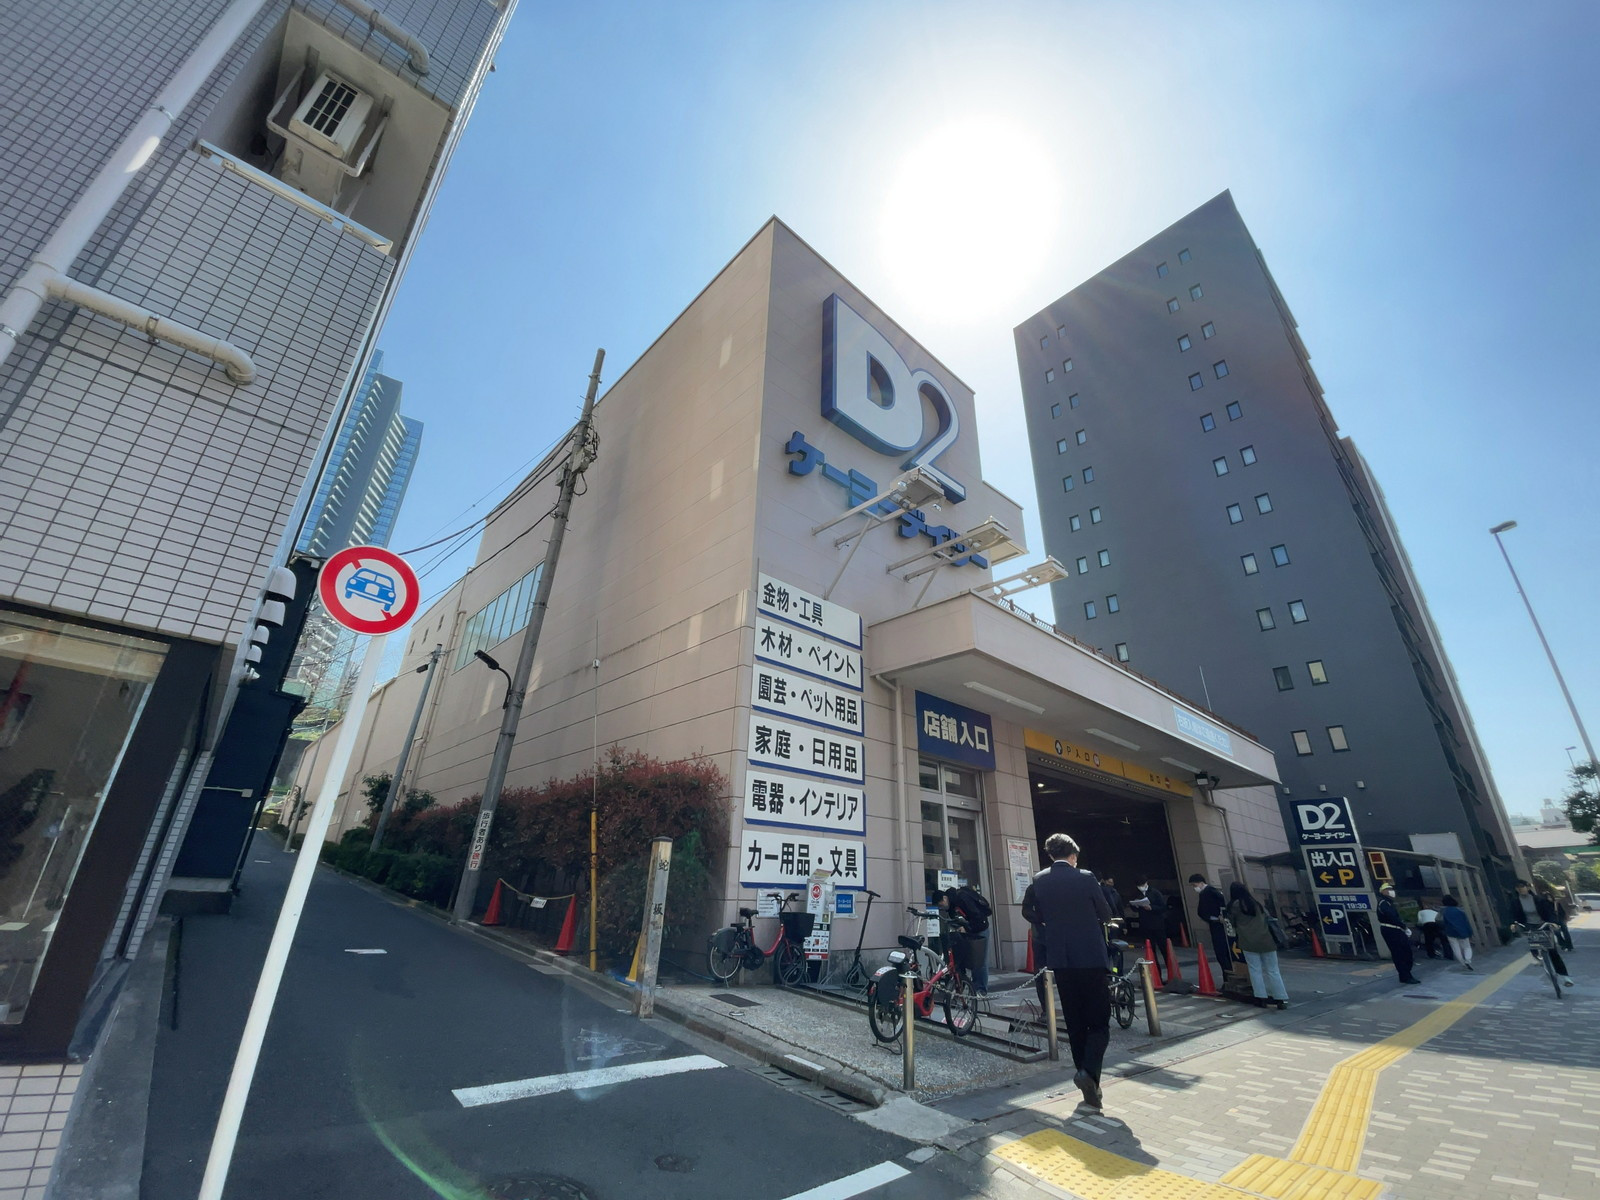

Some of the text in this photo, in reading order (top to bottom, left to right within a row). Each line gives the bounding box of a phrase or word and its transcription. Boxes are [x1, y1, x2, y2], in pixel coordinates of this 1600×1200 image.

[821, 292, 966, 504] D2
[762, 582, 824, 627] 金物・工具
[760, 626, 856, 678] 木材・ペイント
[758, 673, 858, 725] 園芸・ペット用品
[754, 725, 858, 774] 家庭・日用品
[923, 710, 990, 753] 店舗入口
[752, 779, 858, 821] 電器・インテリア
[1297, 802, 1346, 831] D2
[747, 840, 858, 879] カー用品・文具
[1310, 851, 1357, 867] 出入口
[1338, 869, 1355, 885] P
[1330, 909, 1344, 924] P
